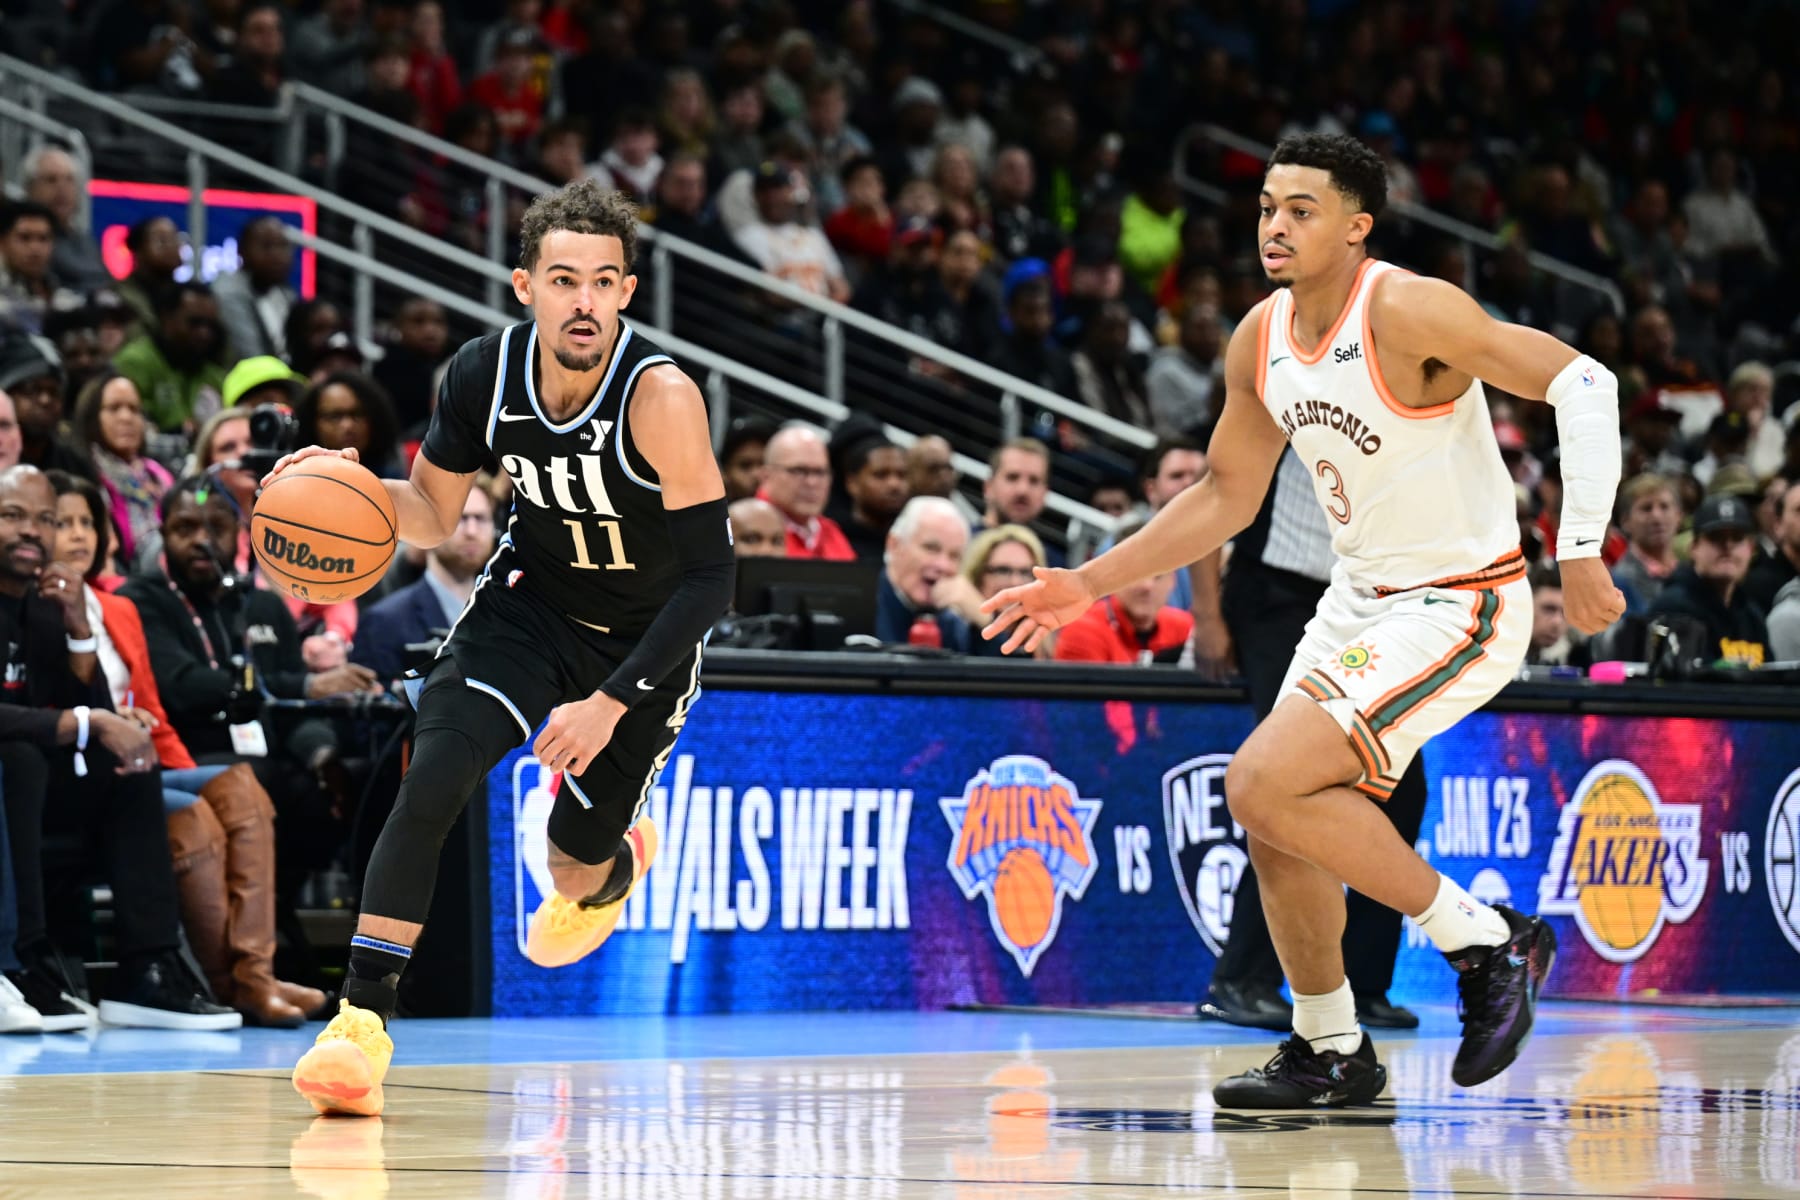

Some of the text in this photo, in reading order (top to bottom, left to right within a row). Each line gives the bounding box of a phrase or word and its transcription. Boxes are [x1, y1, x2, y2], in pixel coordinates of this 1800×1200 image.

[1334, 342, 1362, 364] Self.
[580, 419, 614, 451] the Y
[1294, 400, 1382, 456] ANTONIO
[501, 453, 623, 518] atl
[1316, 459, 1352, 525] 3
[264, 526, 355, 574] Wilson
[562, 519, 636, 570] 11
[955, 783, 1091, 868] KNICKS
[1434, 775, 1532, 859] JAN 23
[612, 755, 914, 964] VALS WEEK
[1114, 824, 1153, 894] VS
[1548, 811, 1693, 908] LAKERS
[1720, 831, 1752, 894] VS
